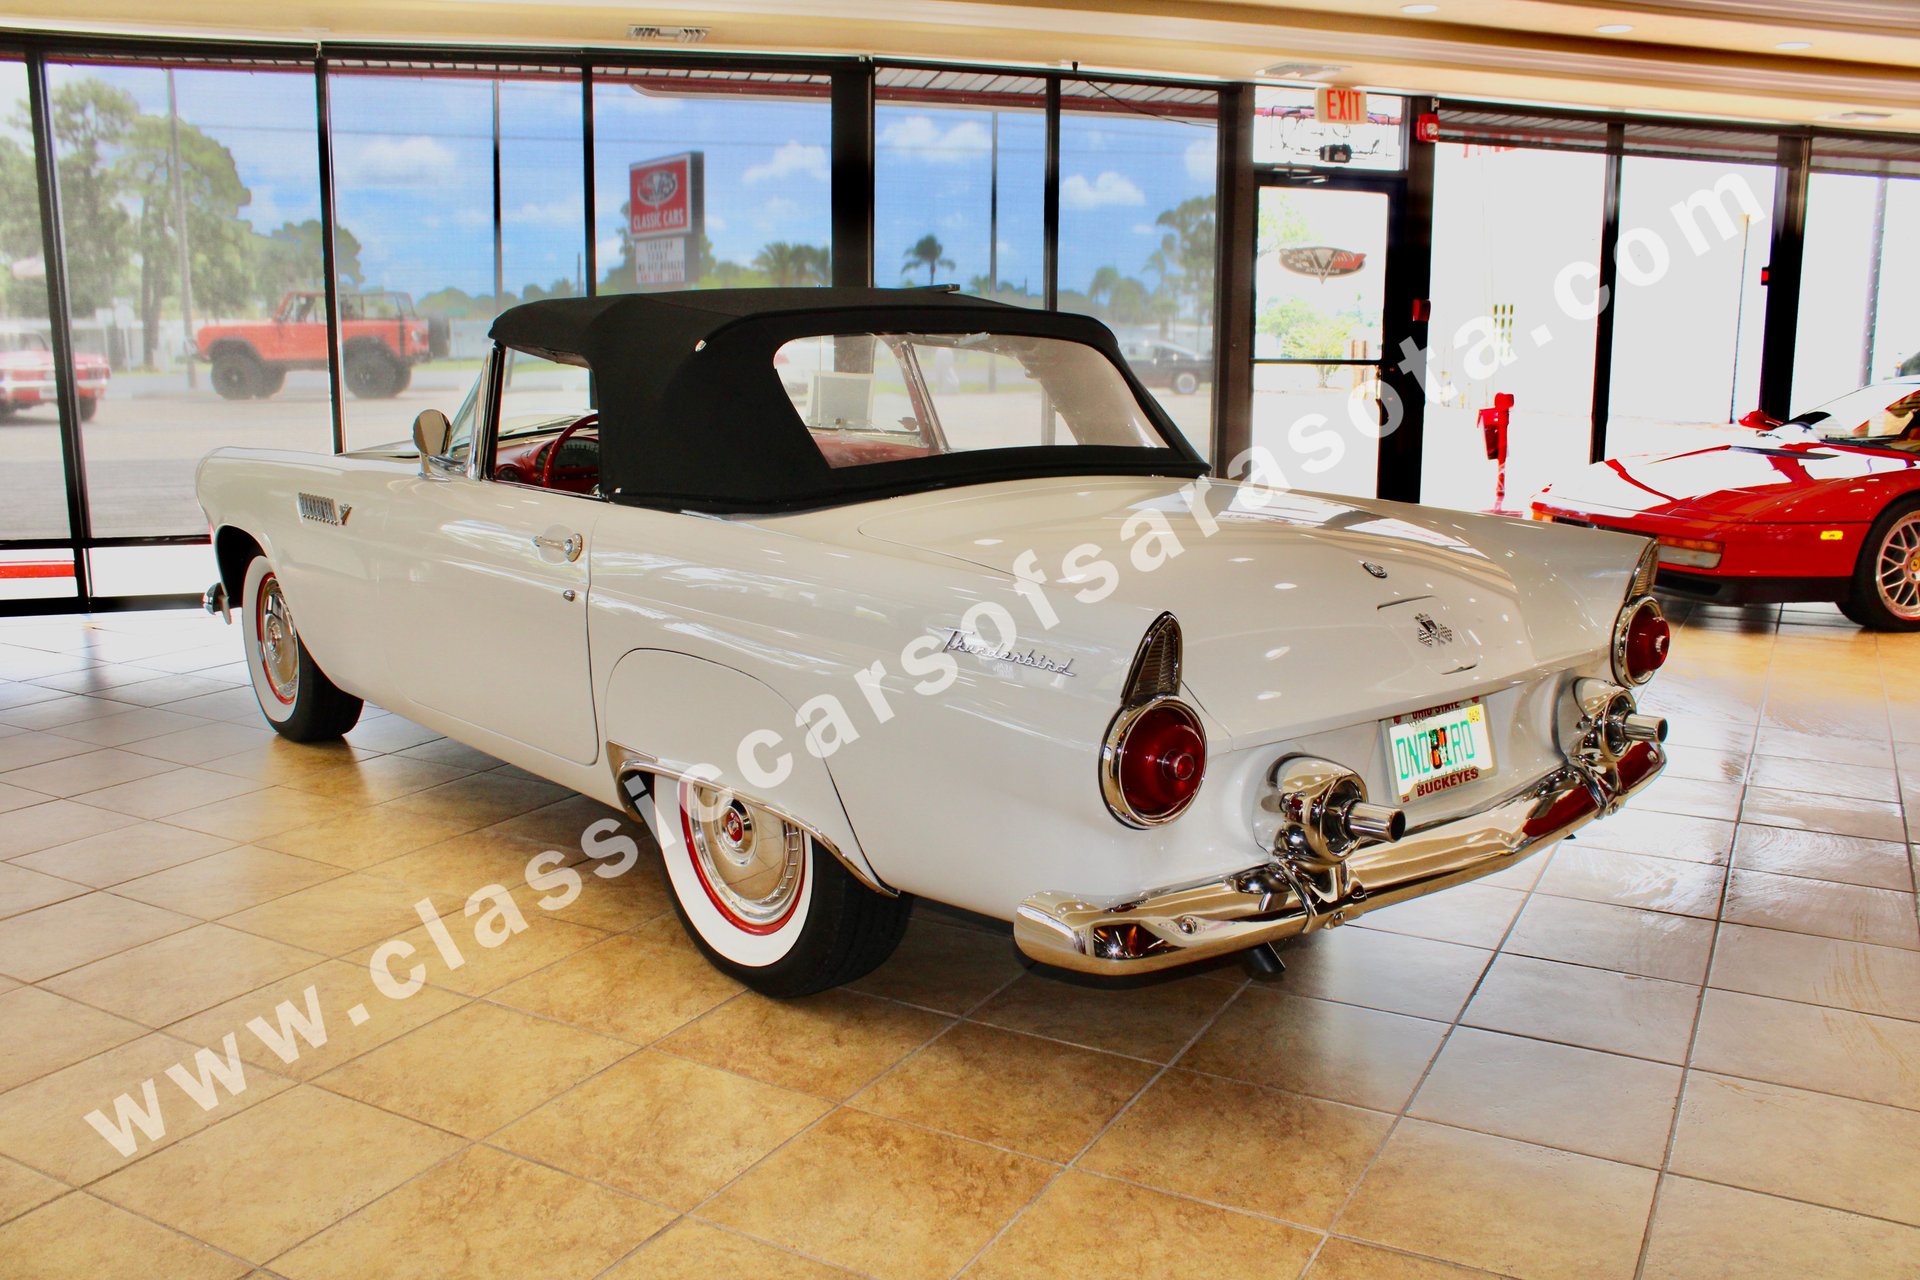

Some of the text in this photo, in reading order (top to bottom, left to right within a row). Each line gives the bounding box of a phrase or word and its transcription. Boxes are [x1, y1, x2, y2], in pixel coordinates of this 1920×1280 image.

[1327, 90, 1361, 121] EXIT
[633, 209, 684, 230] CLASSIC CARS
[943, 627, 1077, 677] Thunderbird
[1416, 767, 1479, 797] BUCKEYES
